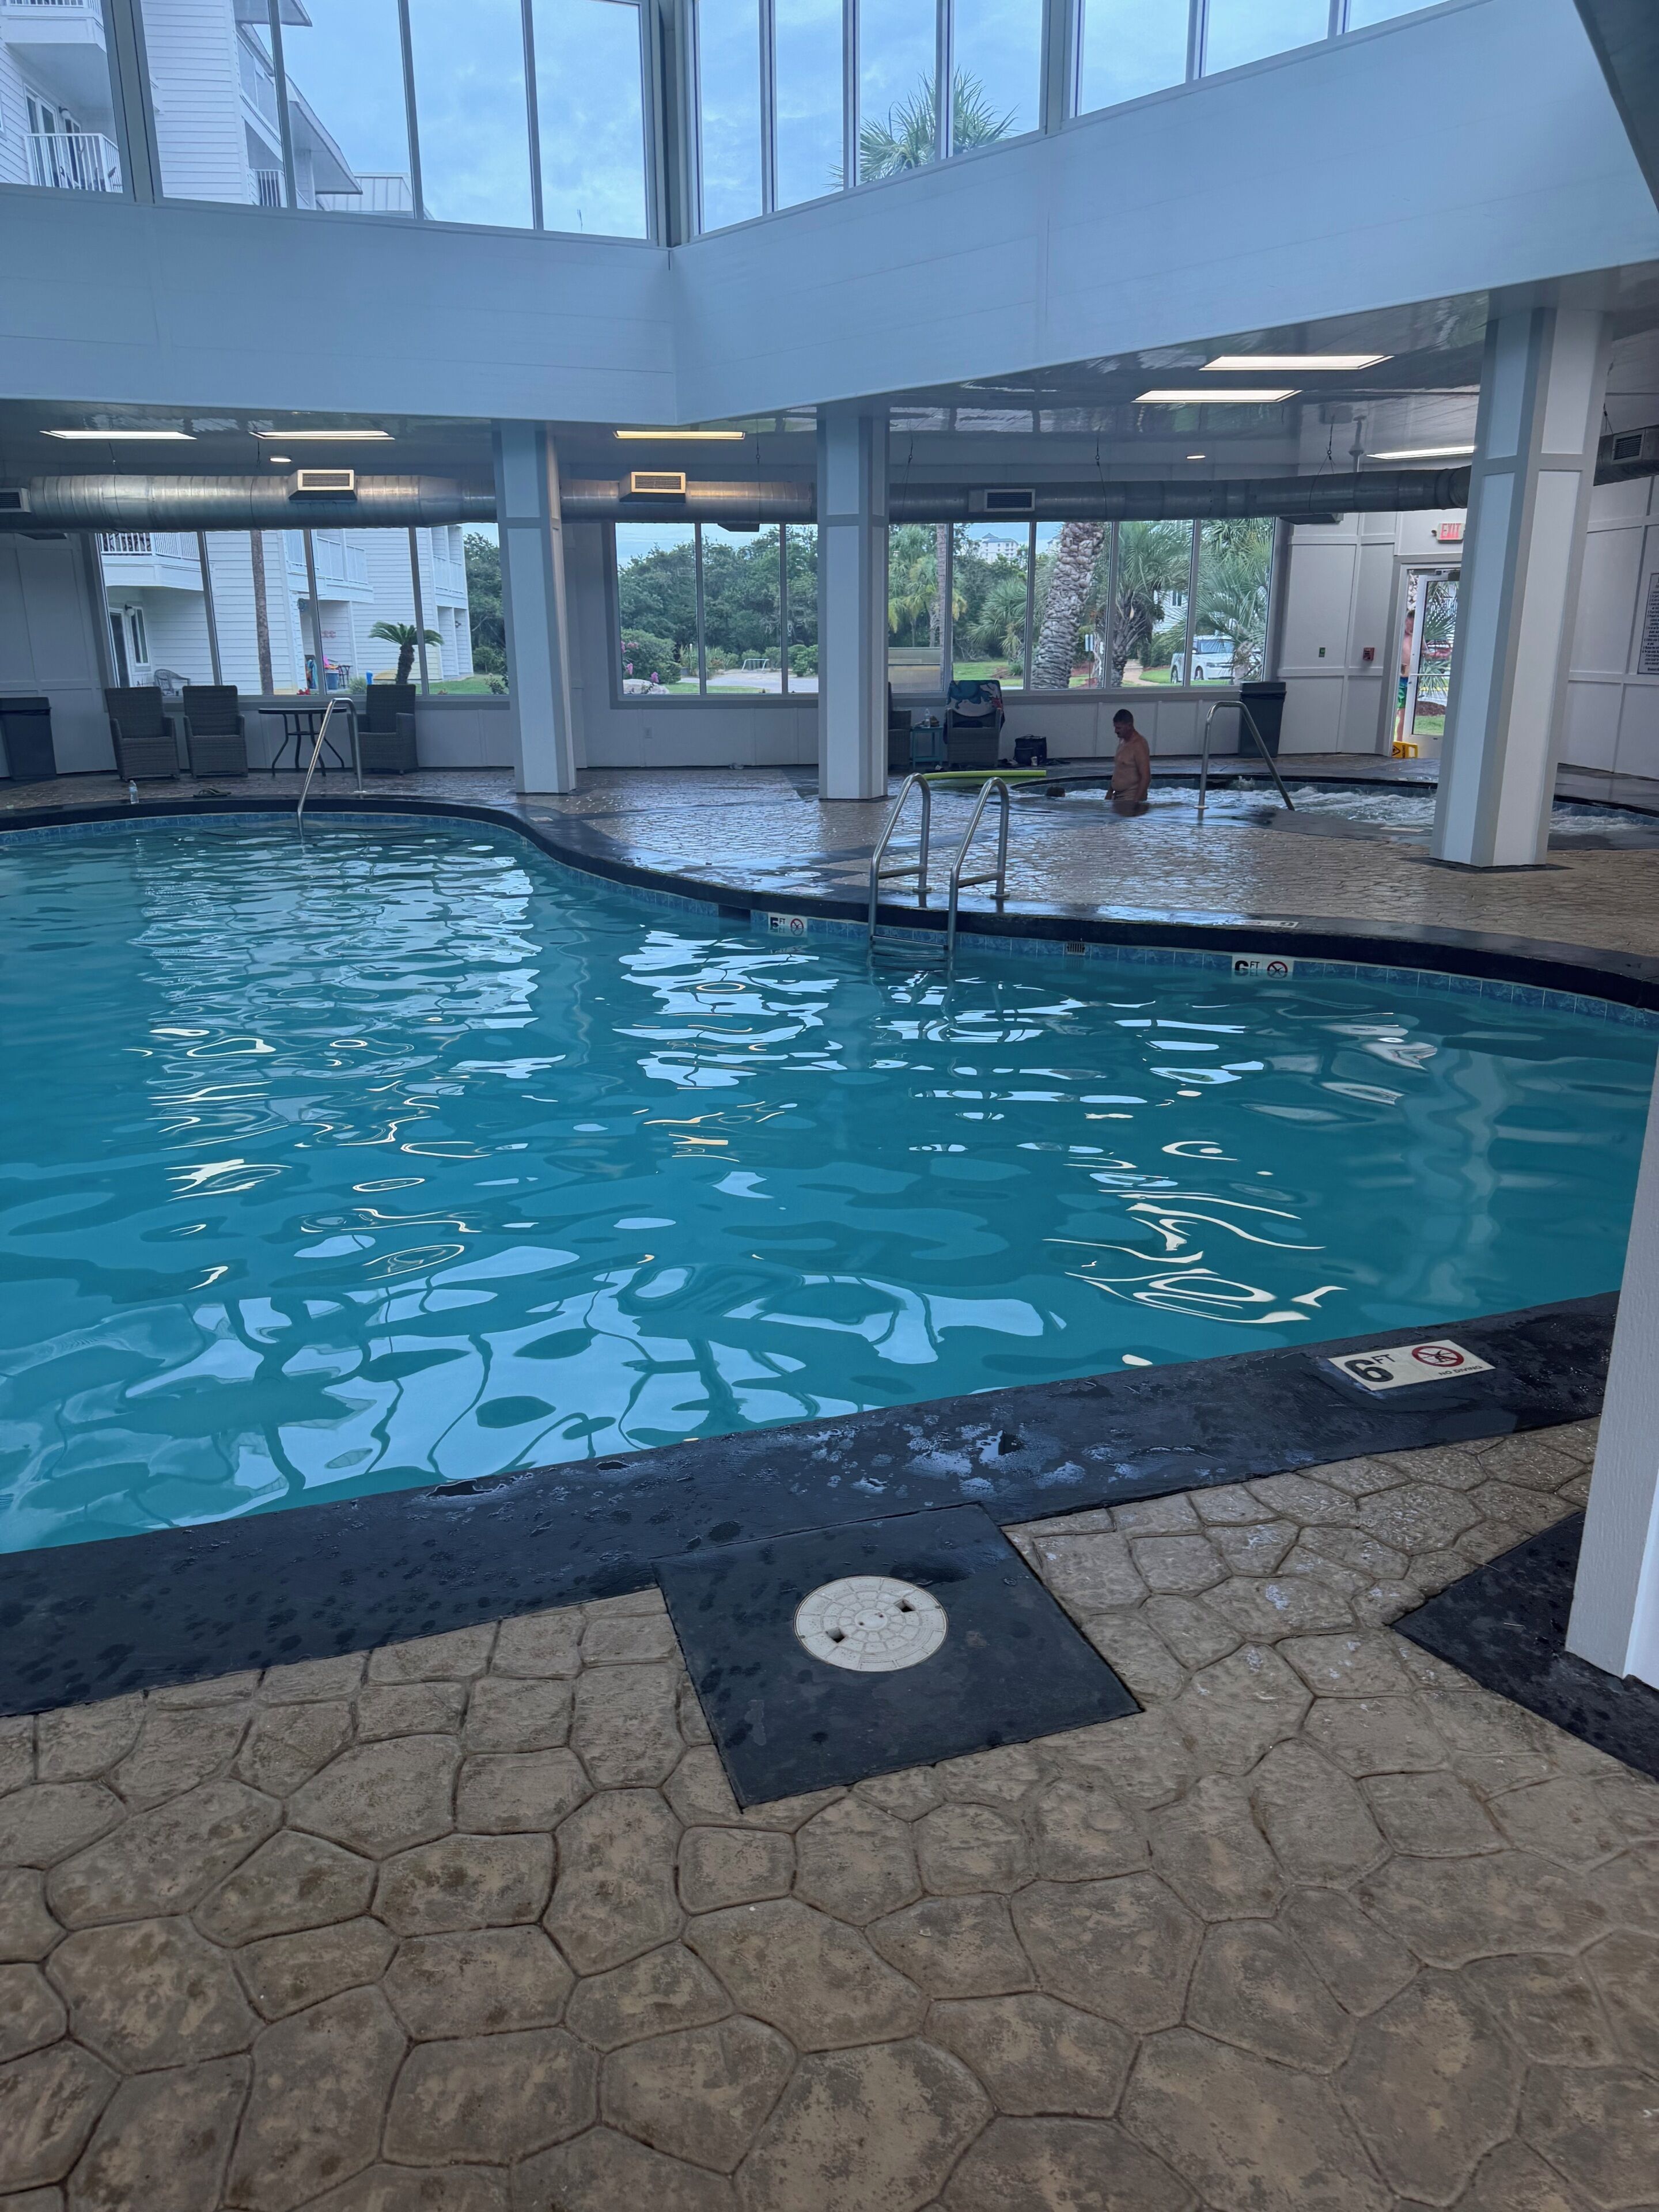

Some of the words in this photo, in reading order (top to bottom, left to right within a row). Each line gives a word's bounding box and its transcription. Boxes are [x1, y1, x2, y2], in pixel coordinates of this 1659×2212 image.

[1440, 523, 1461, 539] EXIT
[1250, 961, 1260, 969] FT
[1344, 1358, 1395, 1382] 6
[1371, 1354, 1396, 1365] FT
[1453, 1365, 1483, 1373] DIVING
